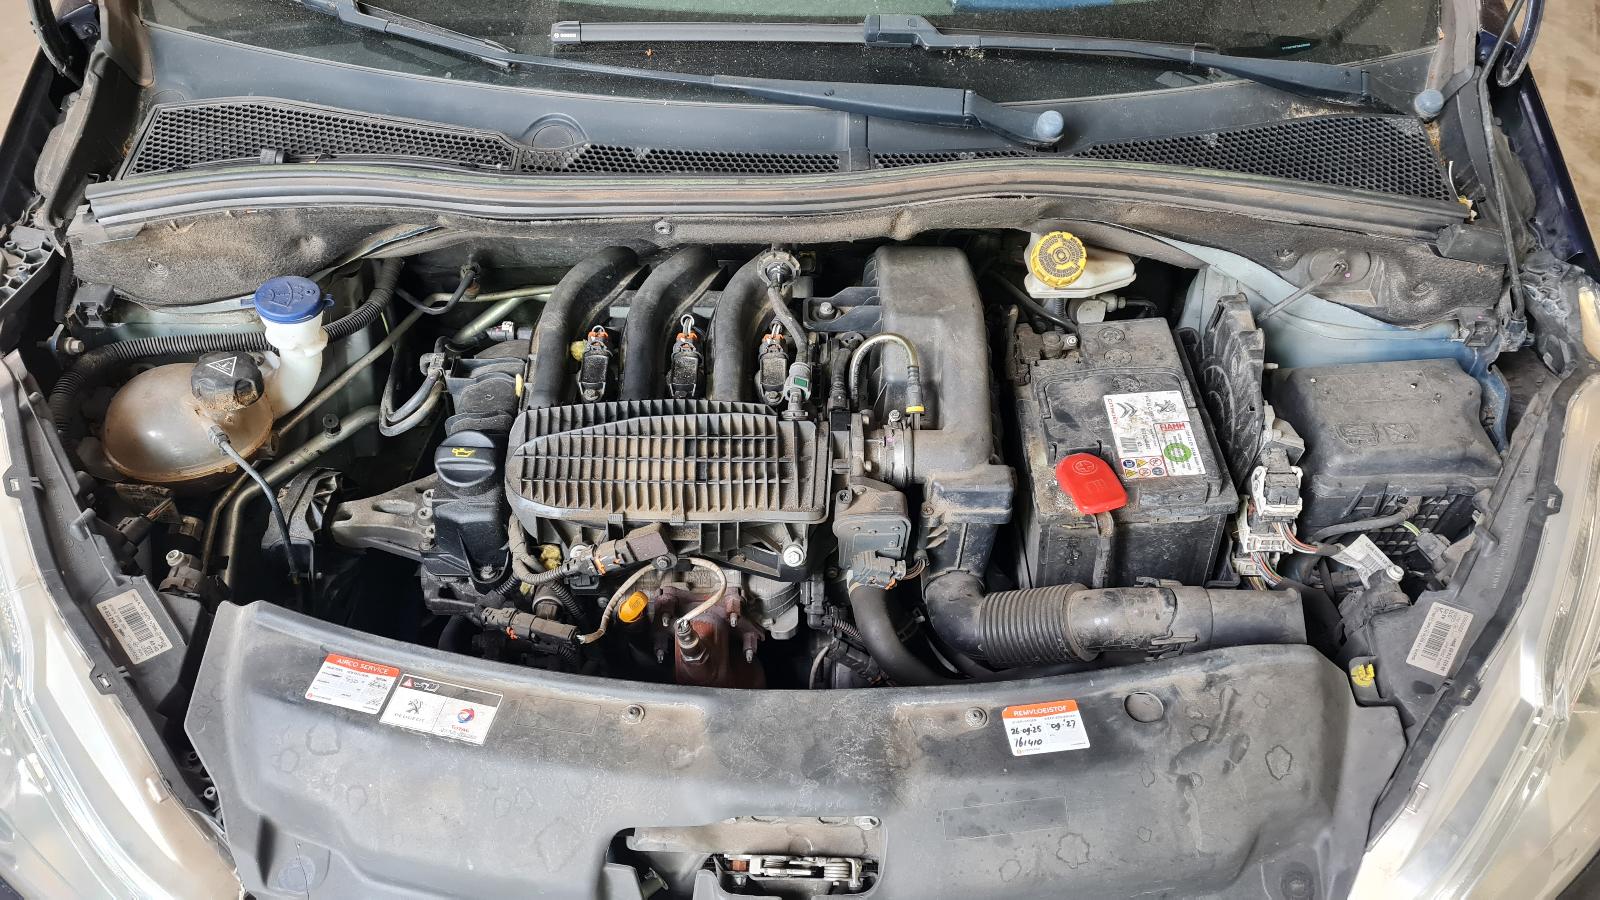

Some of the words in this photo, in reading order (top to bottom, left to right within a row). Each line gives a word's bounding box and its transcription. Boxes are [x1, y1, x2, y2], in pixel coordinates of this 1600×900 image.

[1160, 423, 1185, 431] FIAMM
[336, 658, 359, 667] AIRCO
[359, 664, 389, 674] SERVICE
[1013, 706, 1067, 716] REMVLOEISTOF
[1014, 735, 1043, 748] 161410
